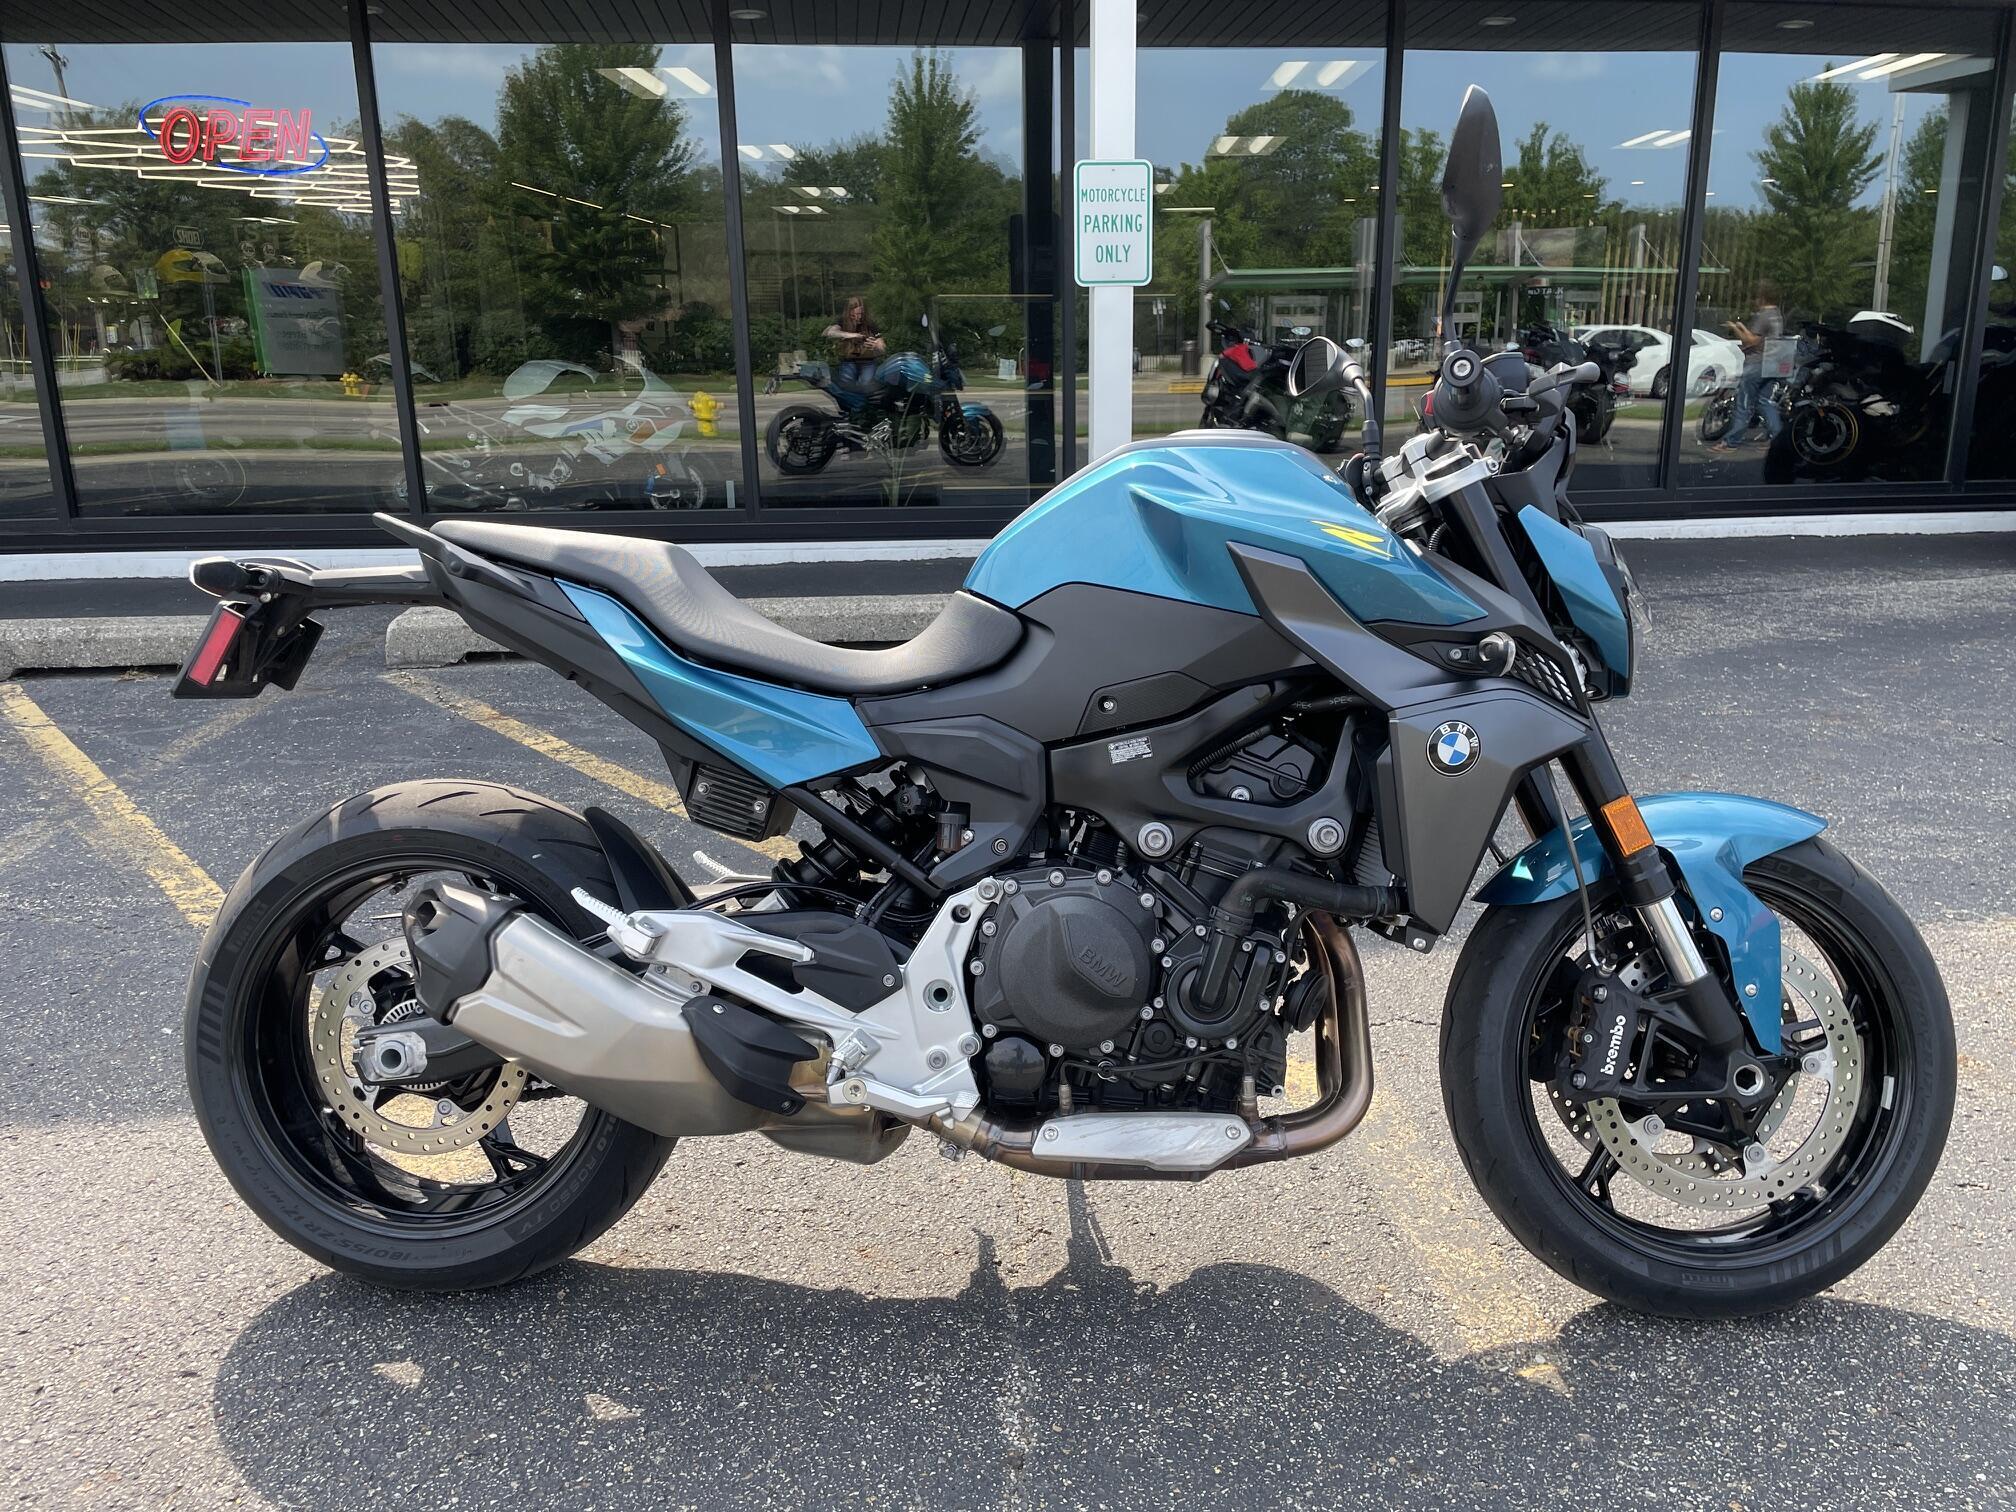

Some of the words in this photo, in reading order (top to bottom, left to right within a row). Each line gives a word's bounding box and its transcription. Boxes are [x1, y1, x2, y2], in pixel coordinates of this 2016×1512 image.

[160, 107, 312, 164] OPEN
[1081, 188, 1146, 203] MOTORCYCLE
[1084, 214, 1143, 233] PARKING
[1095, 244, 1132, 263] ONLY
[1439, 723, 1479, 747] BMW
[1079, 946, 1128, 987] BMW
[1600, 1014, 1627, 1076] brembo
